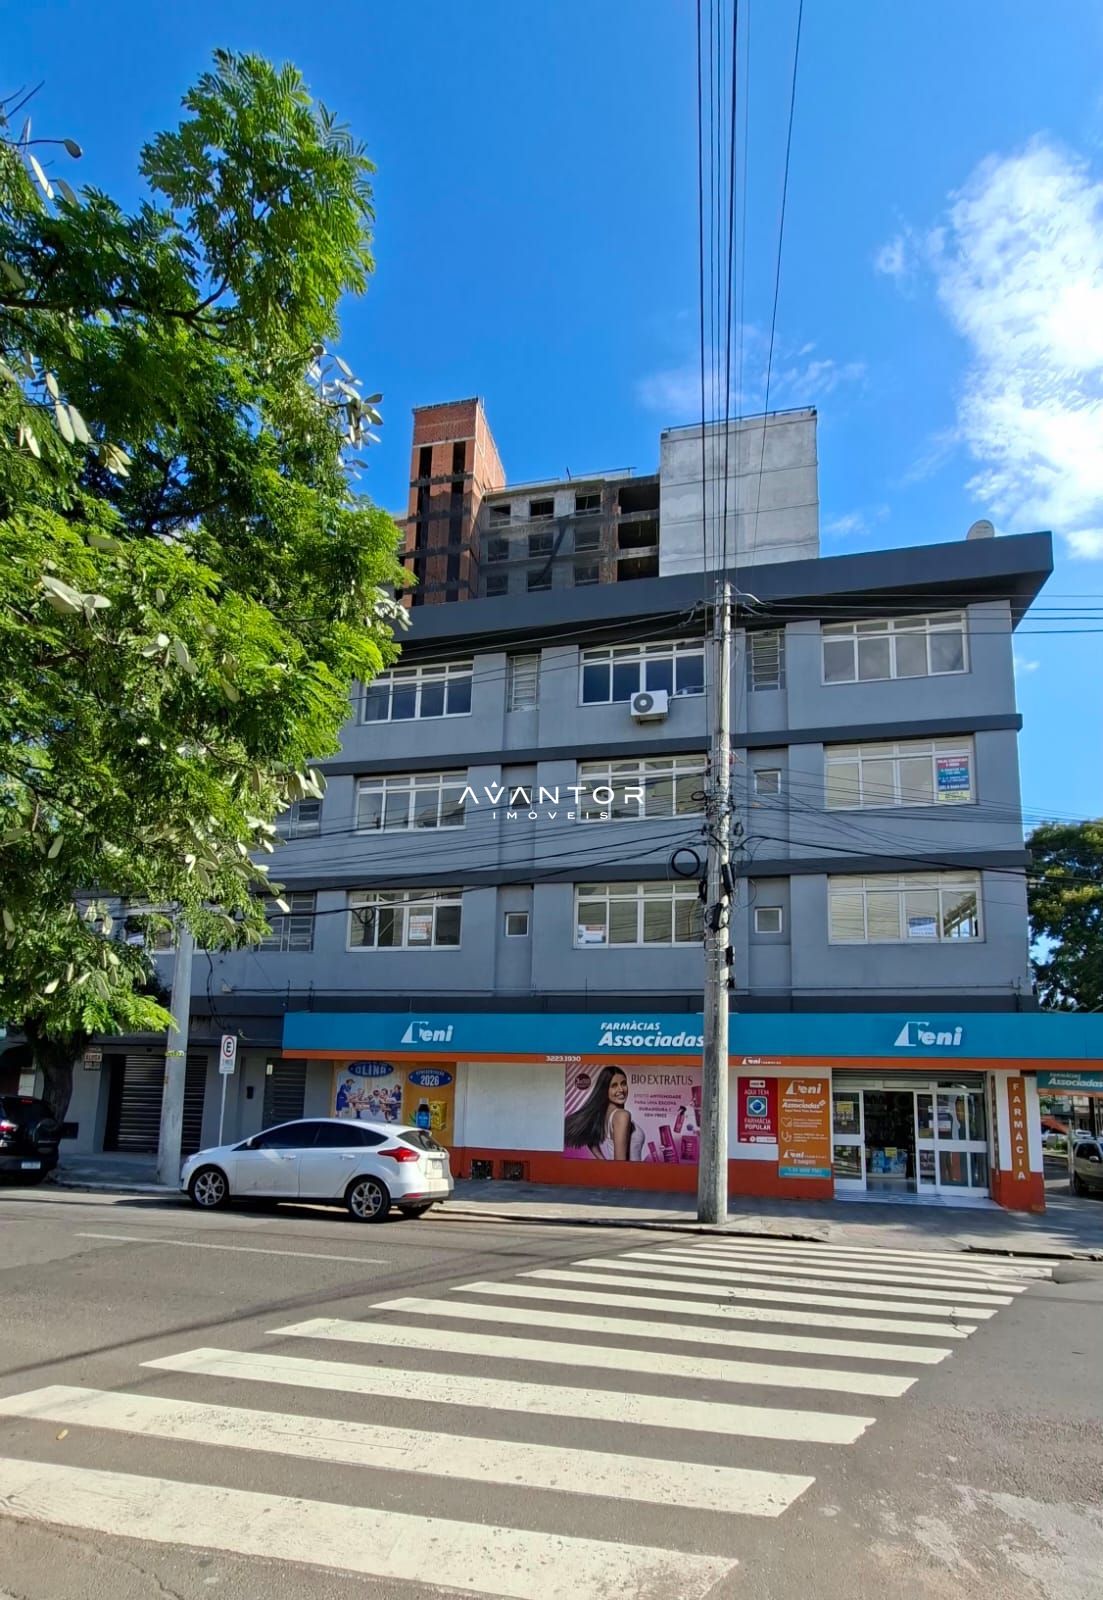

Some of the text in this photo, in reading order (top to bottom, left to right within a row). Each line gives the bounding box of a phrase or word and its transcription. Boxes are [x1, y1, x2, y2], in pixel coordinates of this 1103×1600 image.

[598, 1031, 704, 1047] Associadas
[225, 1041, 232, 1053] E
[420, 1075, 440, 1086] 2026
[631, 1073, 693, 1086] BIO EXTRATUS
[1012, 1083, 1026, 1180] FARMACIA
